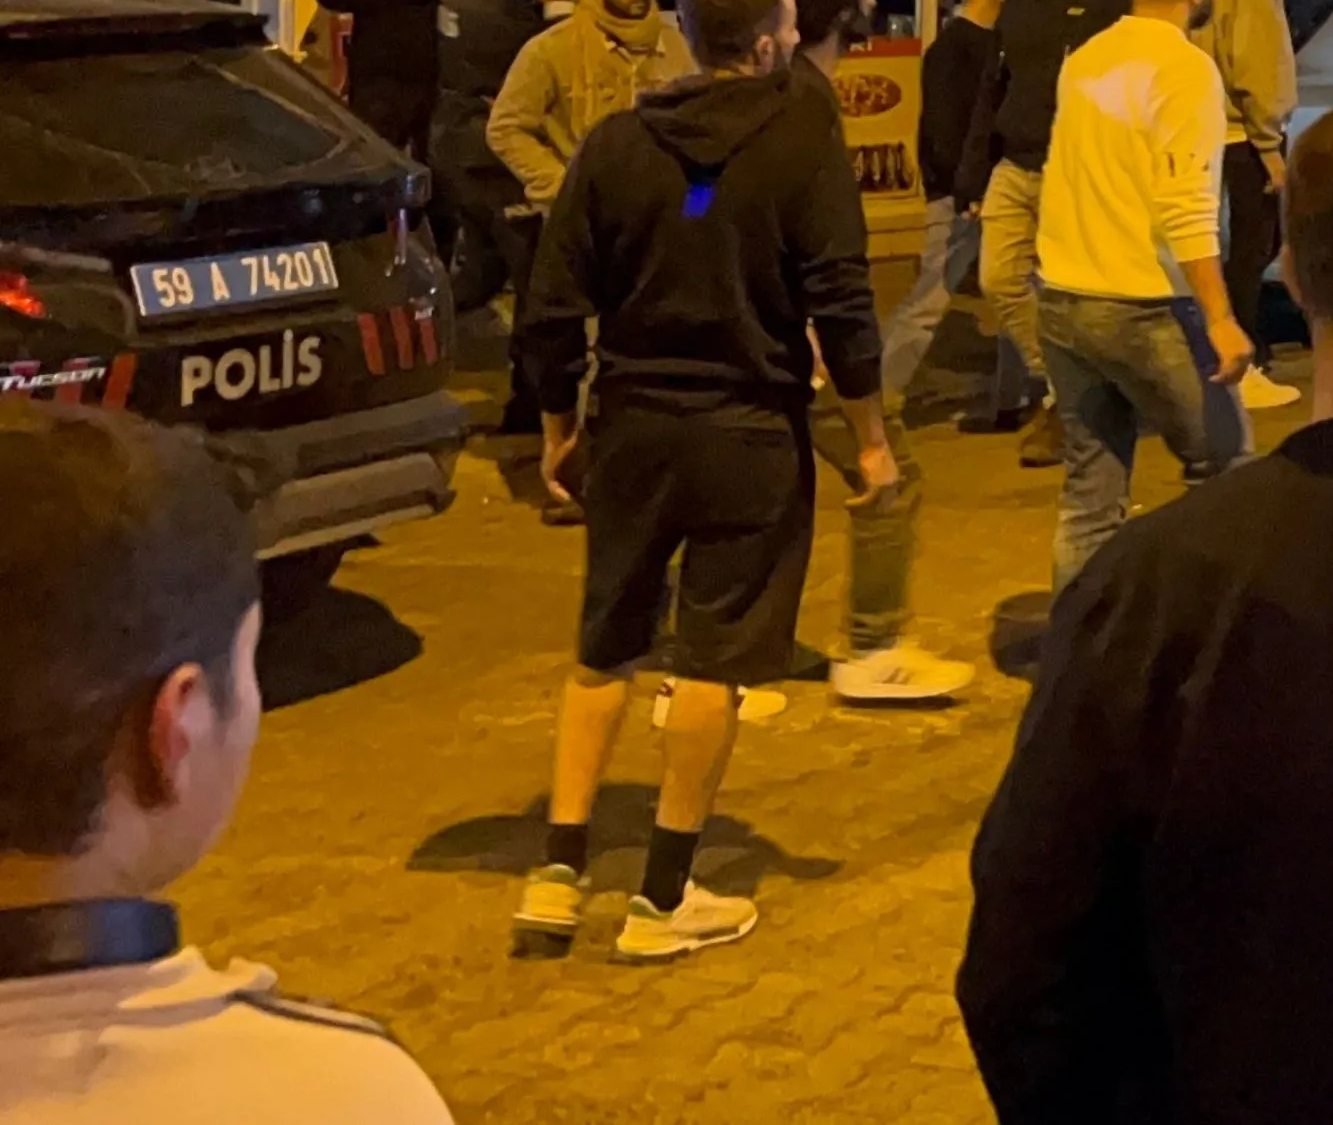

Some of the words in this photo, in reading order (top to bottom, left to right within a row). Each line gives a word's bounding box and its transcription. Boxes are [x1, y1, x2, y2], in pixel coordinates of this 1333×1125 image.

[151, 266, 195, 308] 59
[210, 261, 231, 302] A
[241, 248, 328, 296] 74201
[180, 328, 323, 408] POLİS
